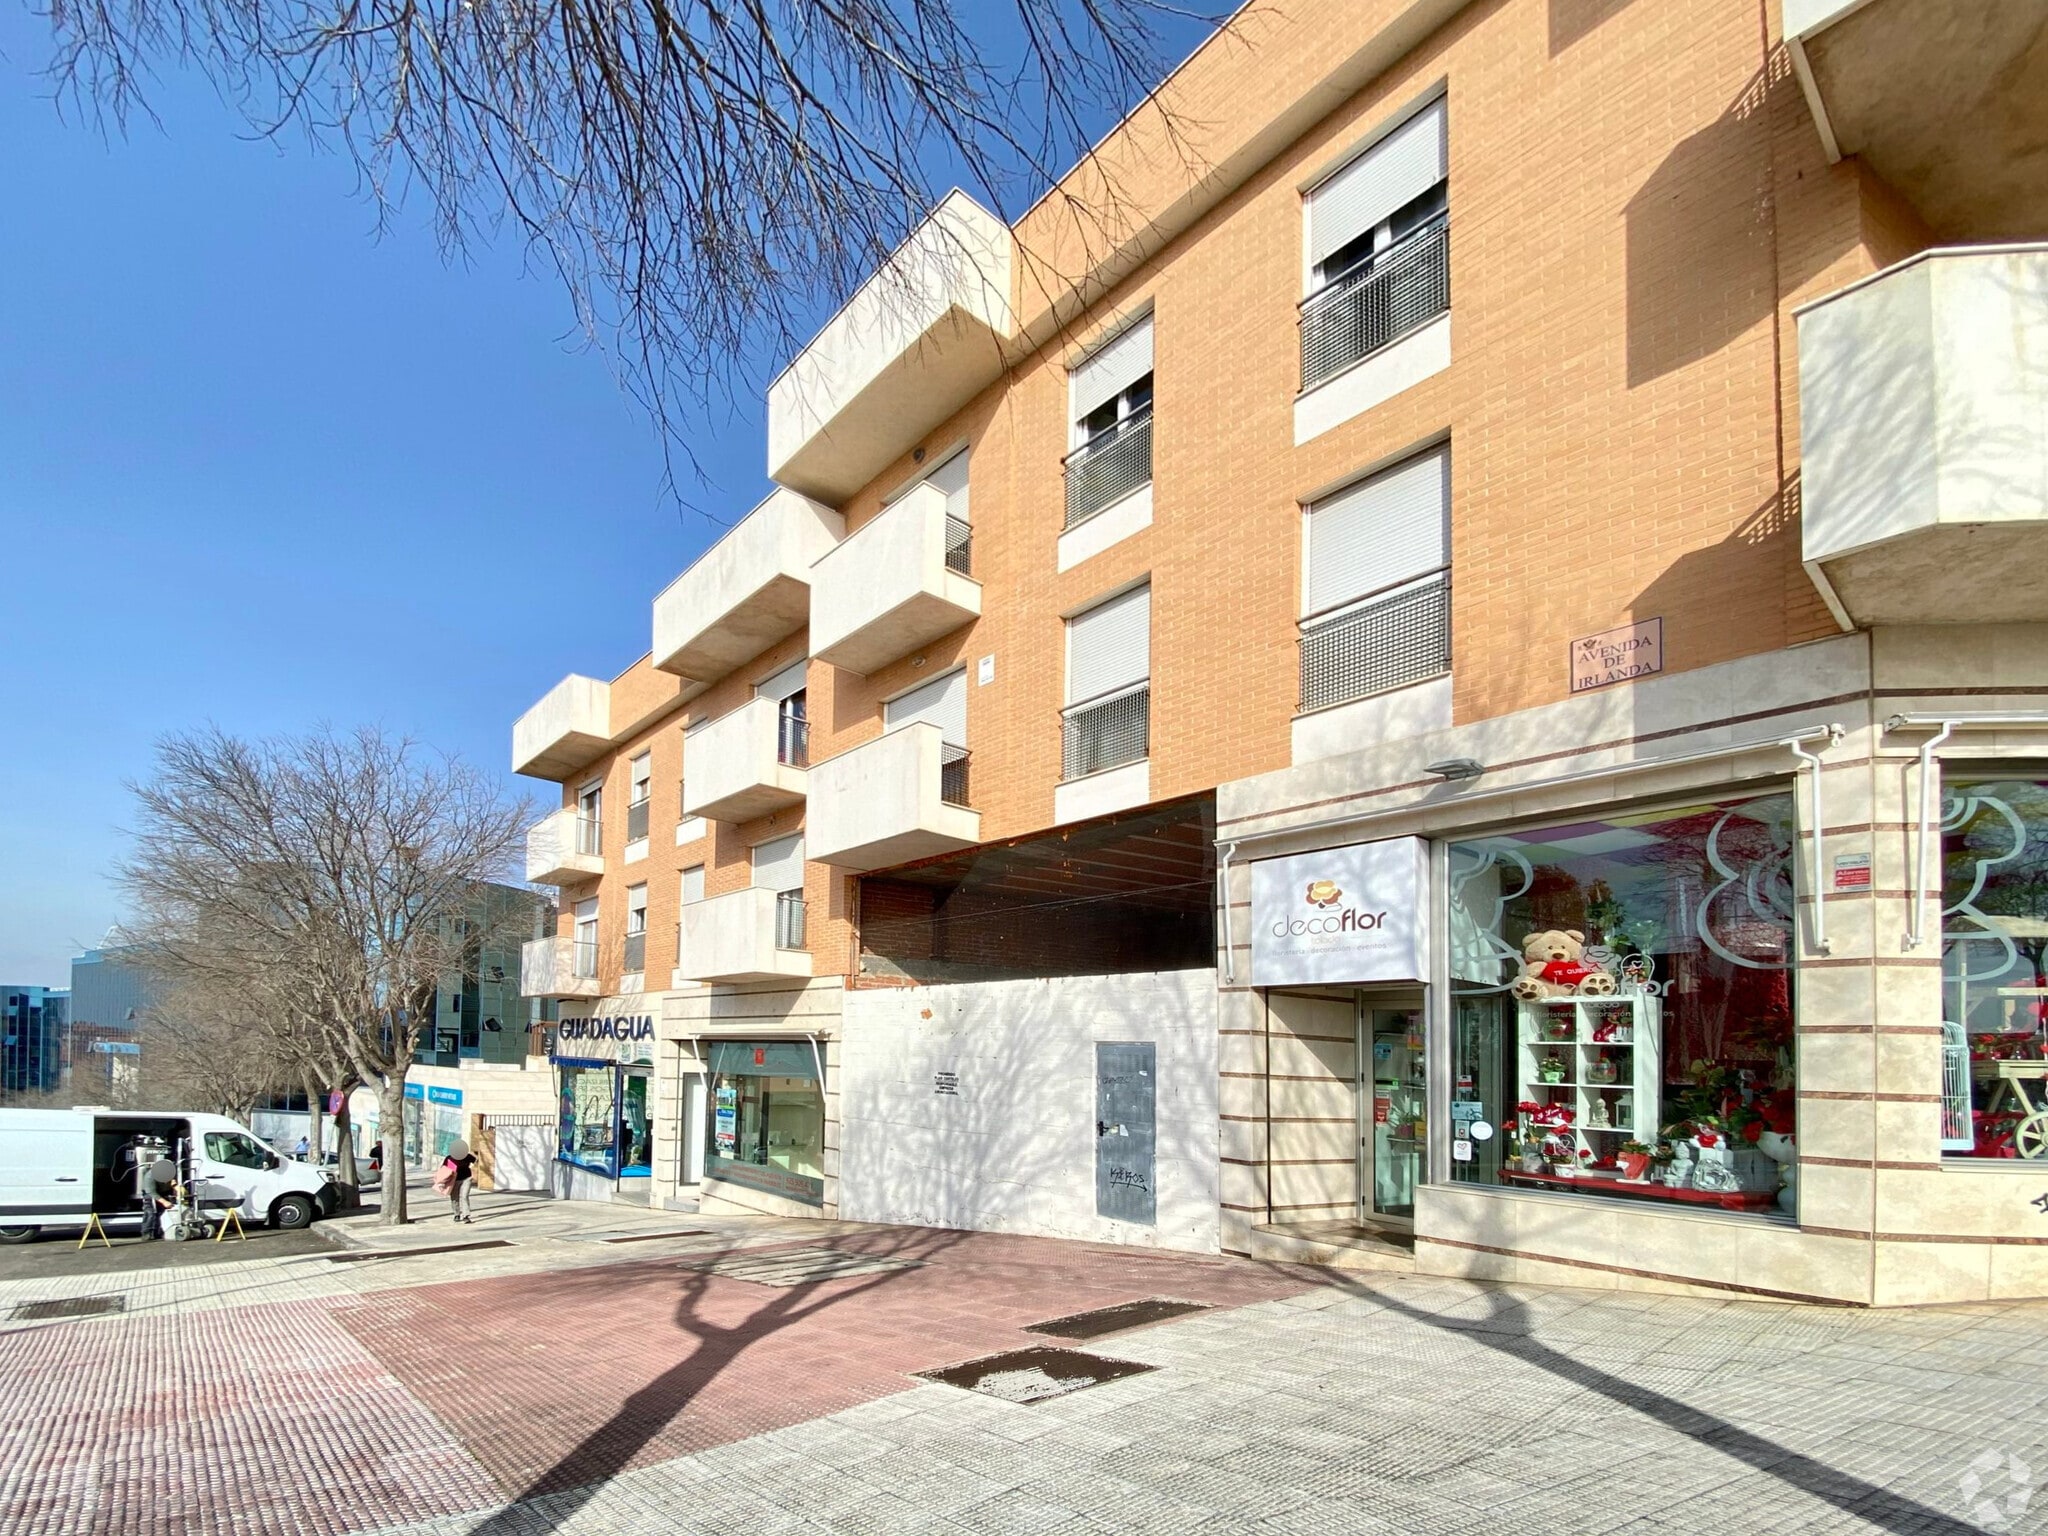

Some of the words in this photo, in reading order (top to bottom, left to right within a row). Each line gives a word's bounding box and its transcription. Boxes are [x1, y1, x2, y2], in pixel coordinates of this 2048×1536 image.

[1578, 635, 1653, 664] AVENIDA
[1603, 654, 1626, 669] DE
[1578, 661, 1653, 689] IRLANDA
[1272, 908, 1387, 938] decoflor
[559, 1015, 655, 1041] GUADAGUA
